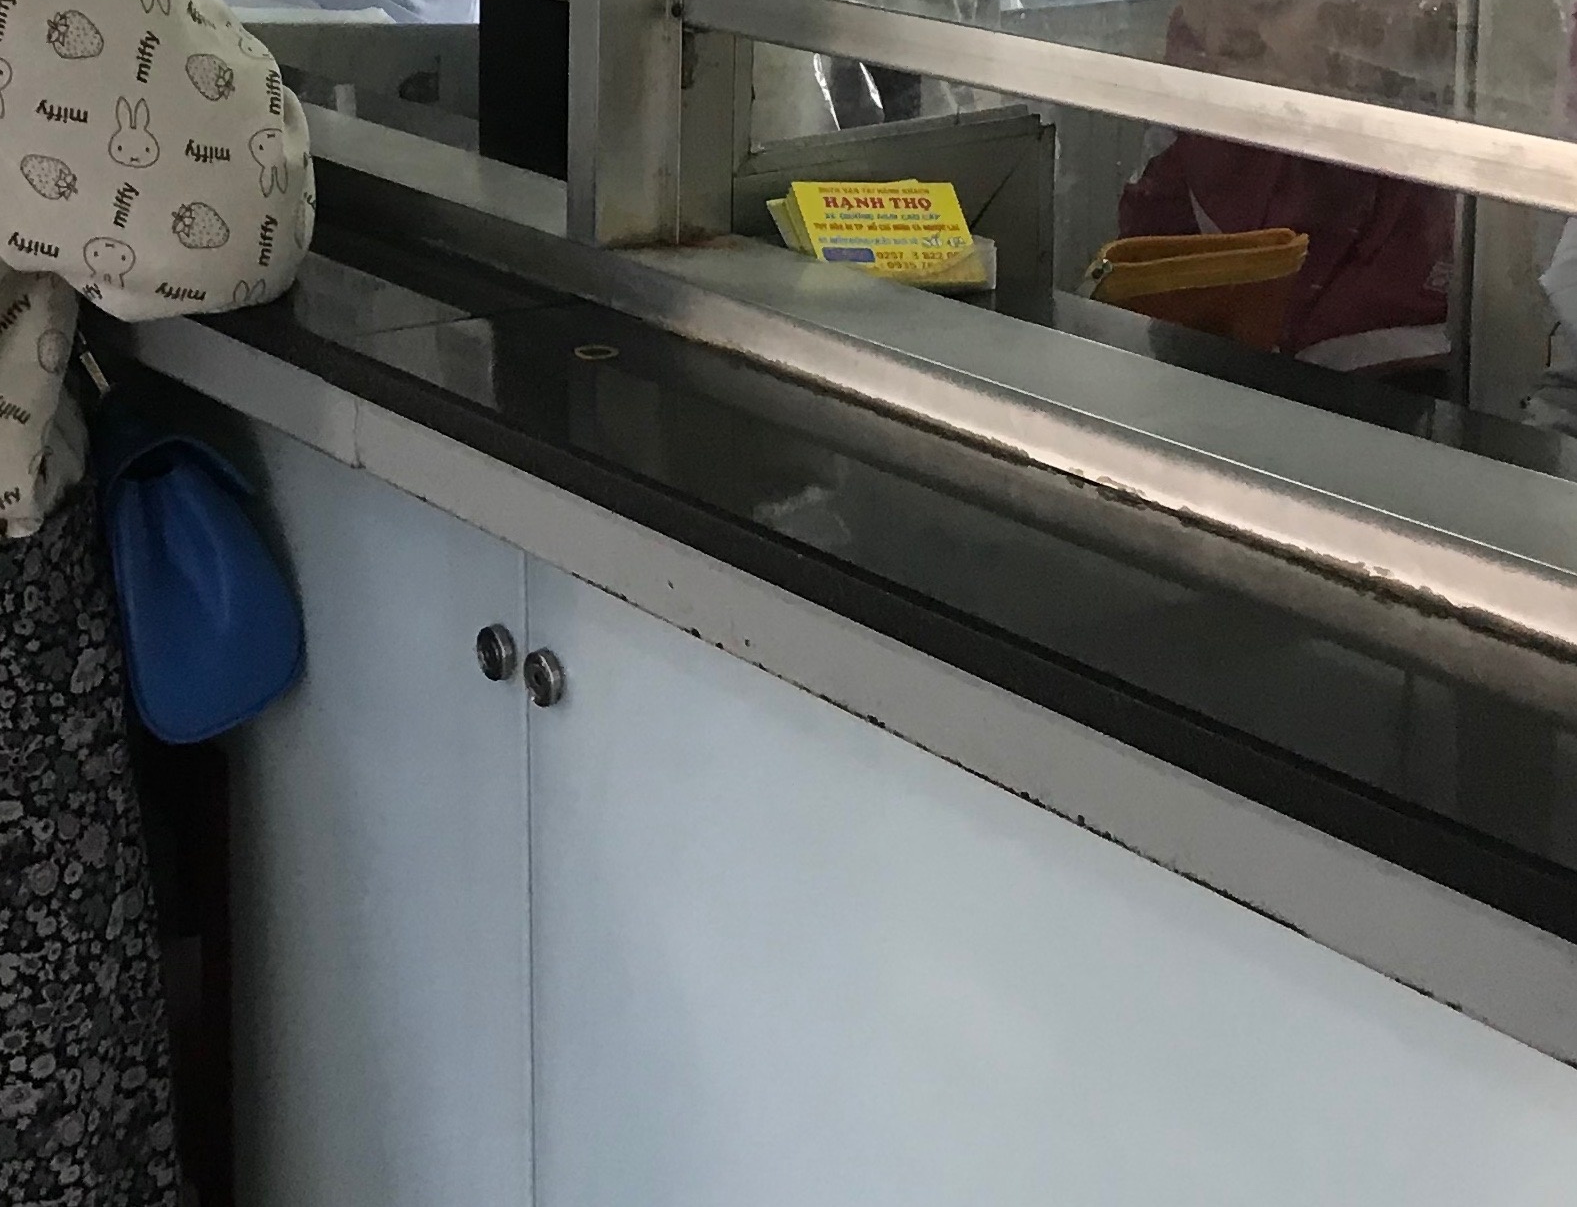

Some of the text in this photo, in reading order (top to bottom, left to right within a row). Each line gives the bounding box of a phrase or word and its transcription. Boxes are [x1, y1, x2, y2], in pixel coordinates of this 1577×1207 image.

[136, 30, 161, 84] miffy
[36, 99, 89, 124] miffy
[185, 139, 231, 163] miffy
[113, 182, 139, 228] miffy
[822, 196, 932, 211] HẠNH THỌ
[7, 232, 59, 258] miffy
[258, 215, 278, 266] miffy
[155, 282, 207, 301] miffy
